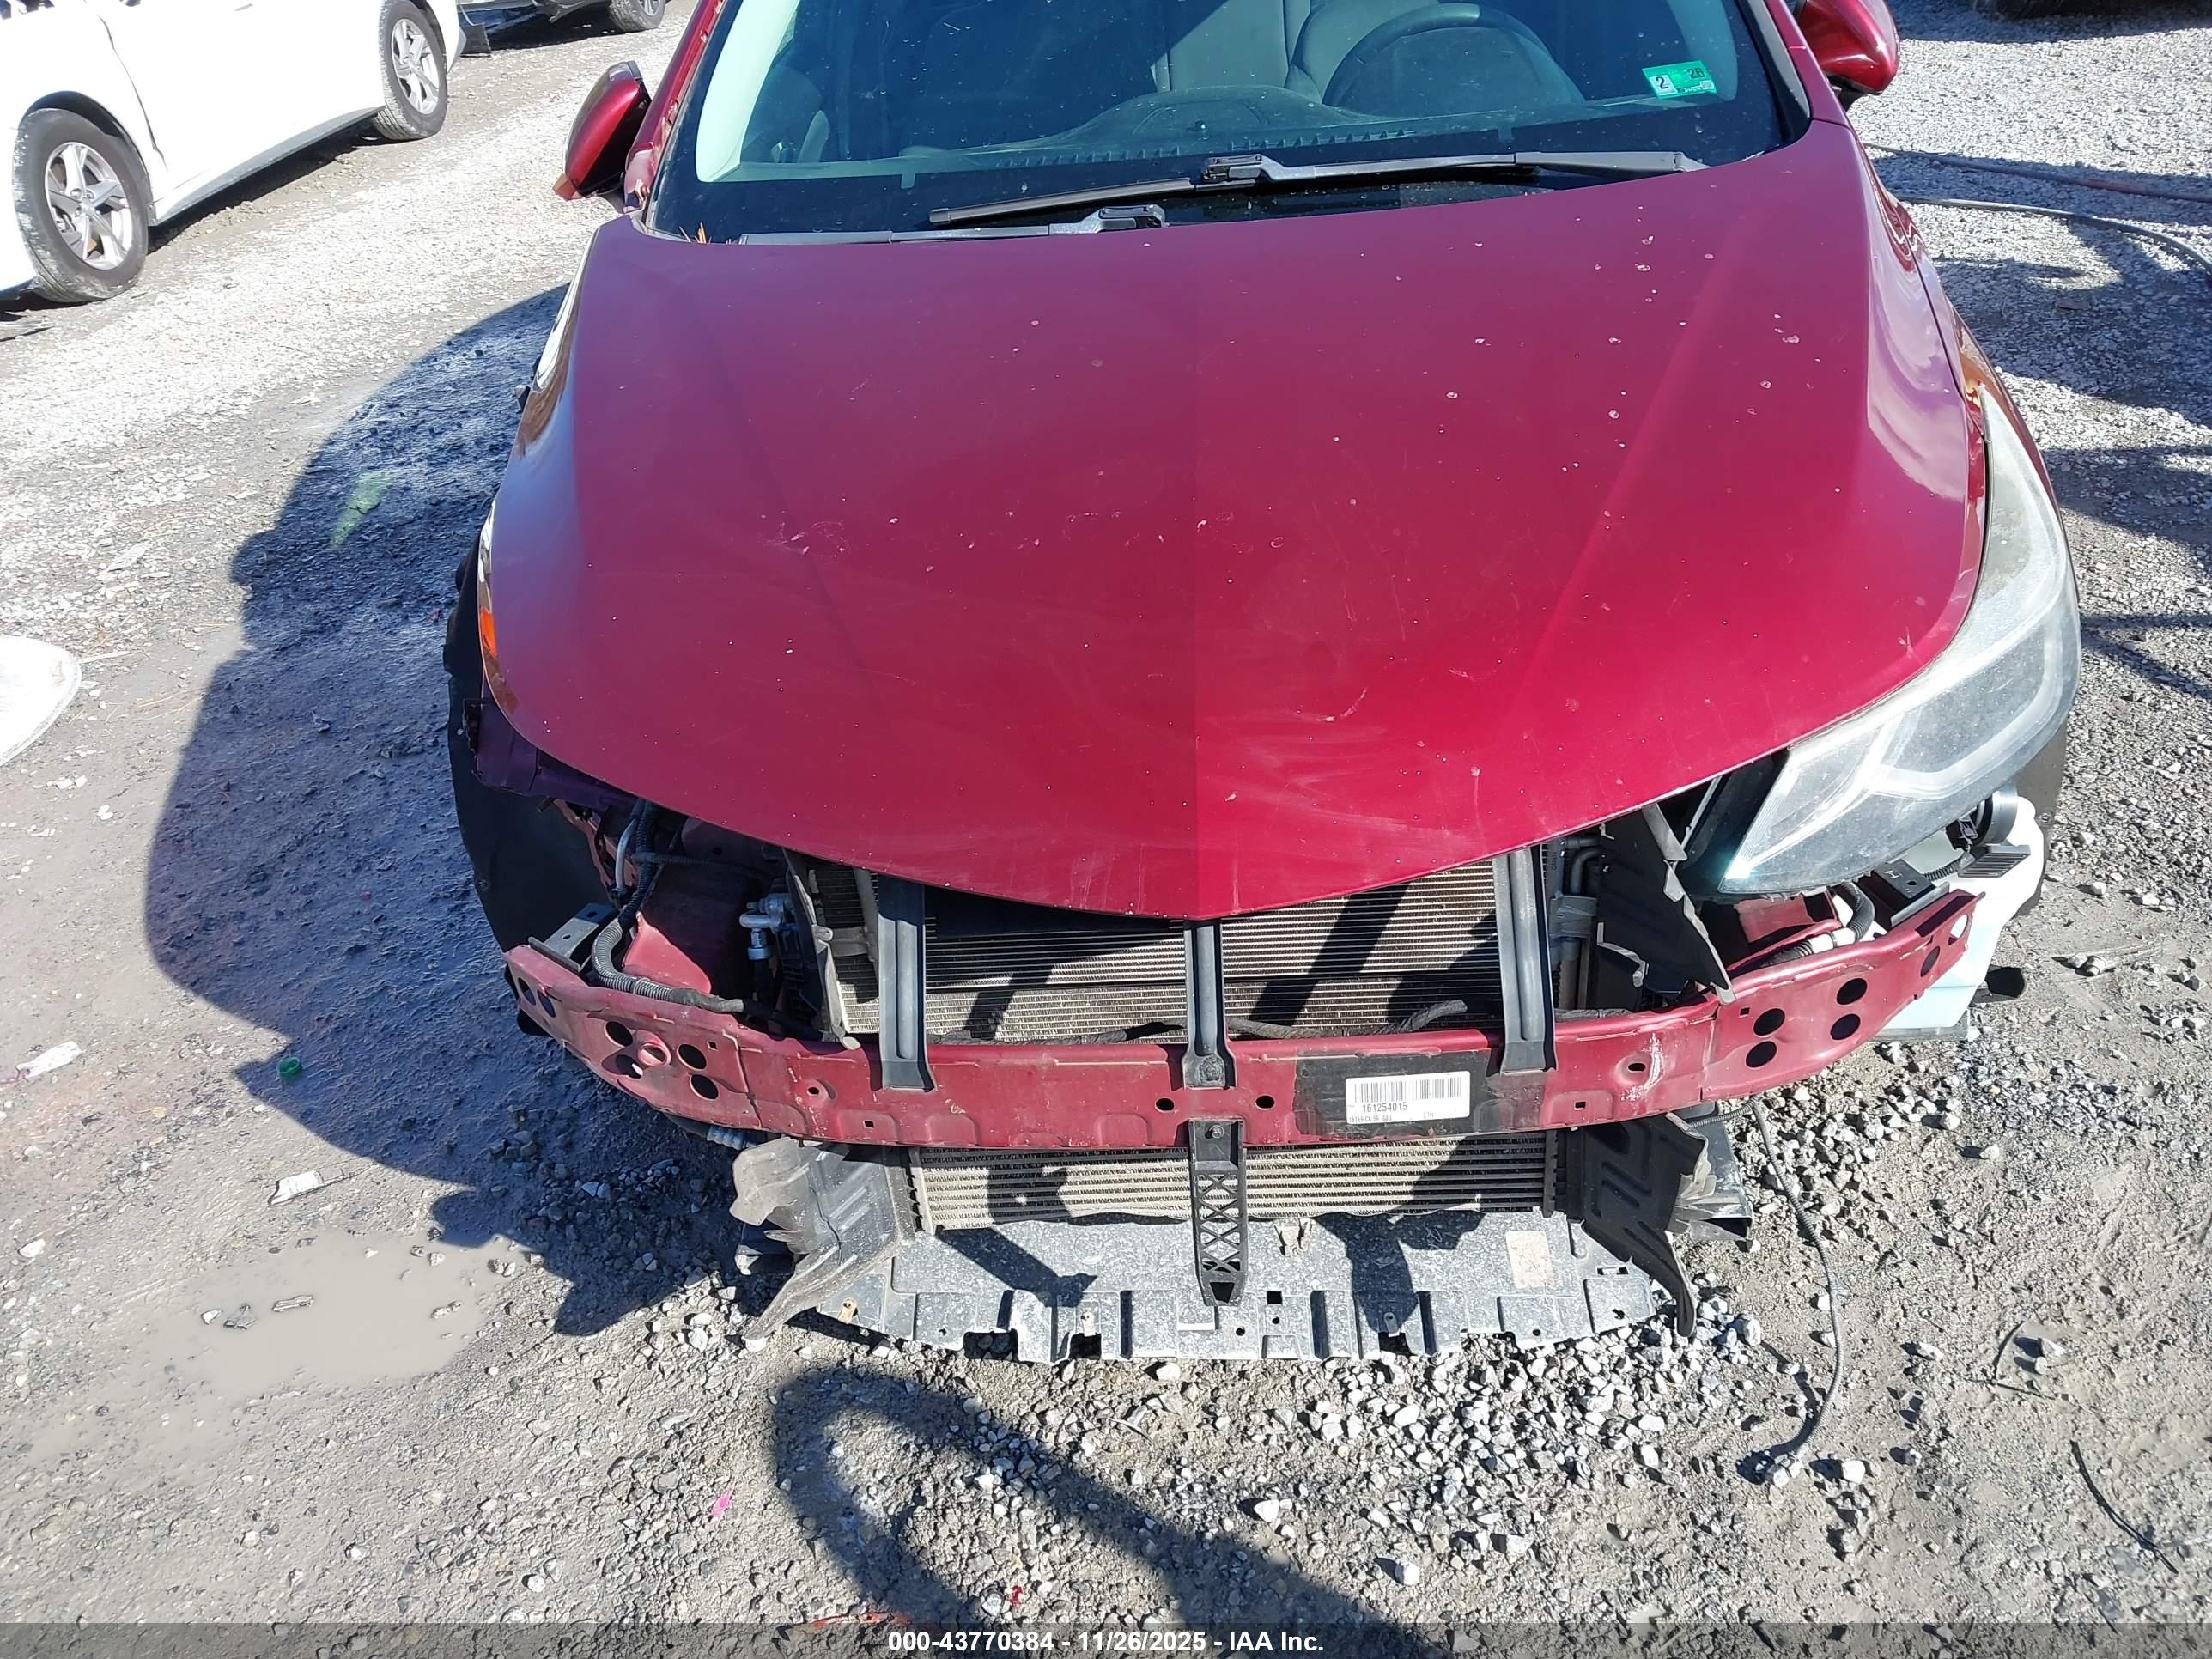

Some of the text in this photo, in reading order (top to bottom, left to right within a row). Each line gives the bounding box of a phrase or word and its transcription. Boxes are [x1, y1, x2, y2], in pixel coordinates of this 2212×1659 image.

[1687, 68, 1705, 79] 26
[1656, 76, 1668, 89] 2
[1362, 1102, 1408, 1113] 161254015
